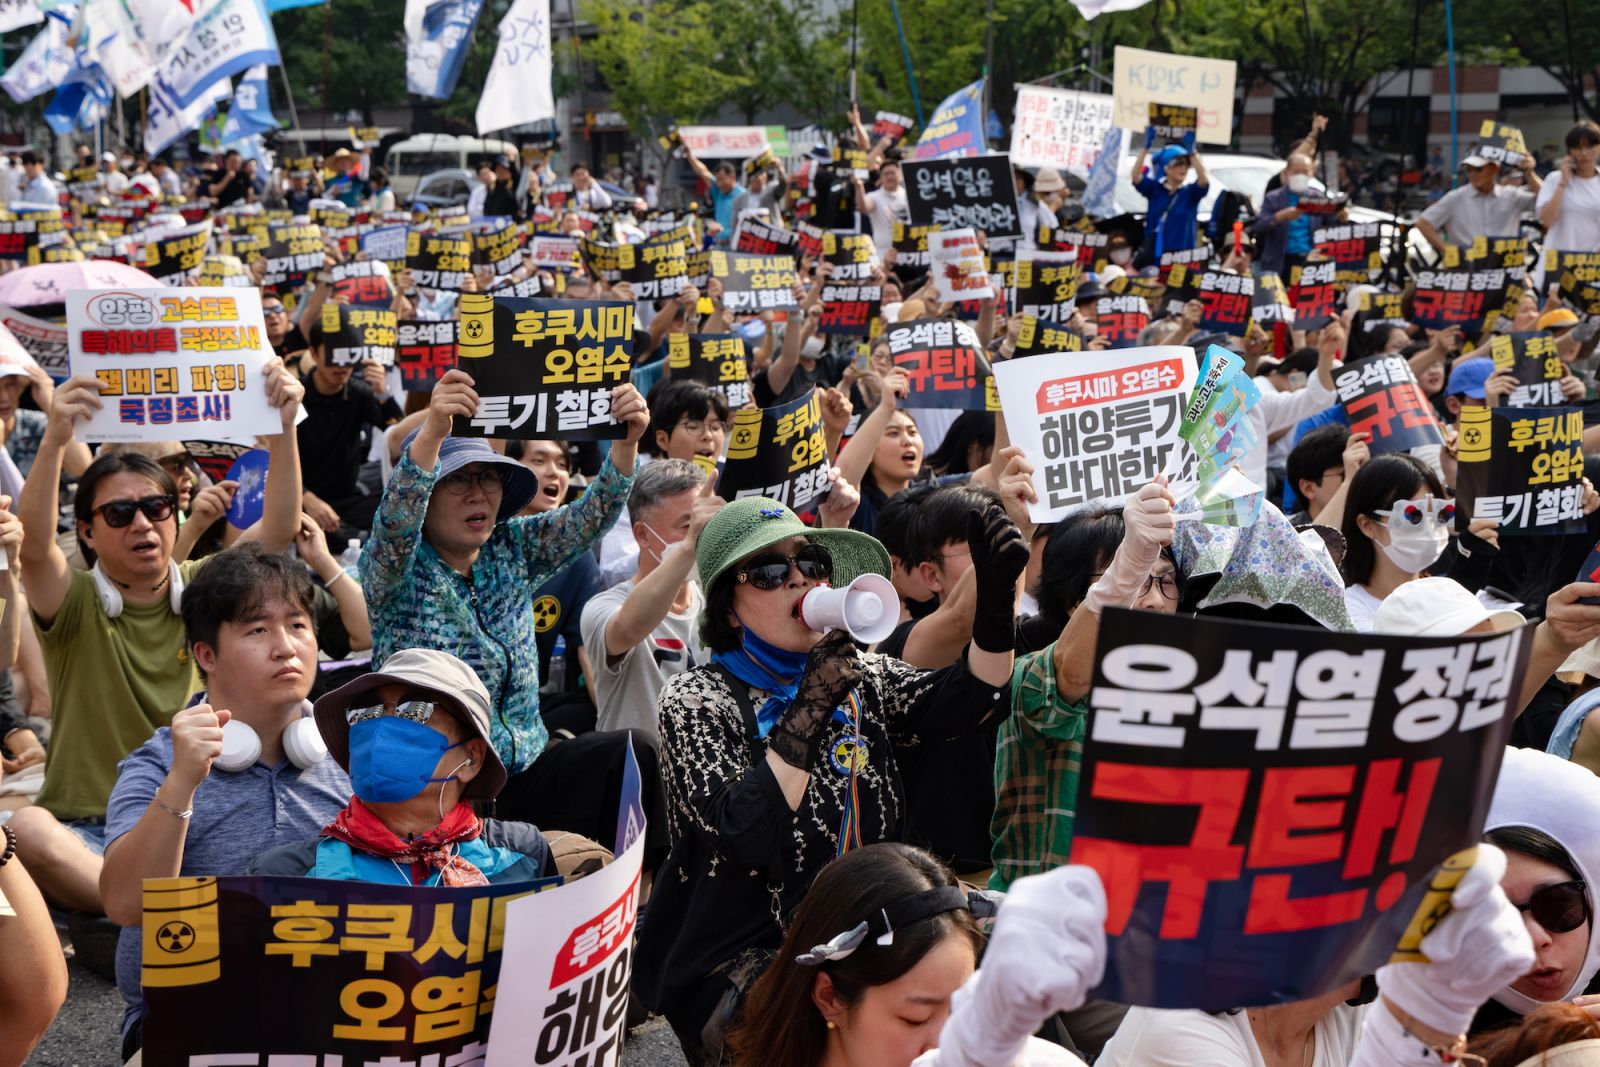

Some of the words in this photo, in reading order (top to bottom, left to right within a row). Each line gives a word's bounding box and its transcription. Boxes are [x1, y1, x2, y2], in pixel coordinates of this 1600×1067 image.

[735, 255, 794, 274] 후쿠시마
[1415, 271, 1469, 291] 윤석열
[1470, 268, 1505, 291] 정권
[751, 273, 795, 289] 오염수
[822, 286, 859, 301] 윤석열
[99, 298, 153, 325] 양평
[160, 296, 239, 323] 고속도로
[723, 290, 757, 309] 투기
[821, 302, 869, 326] 규탄!
[1412, 290, 1484, 321] 규탄!
[81, 327, 178, 356] 특혜의혹
[399, 321, 454, 345] 윤석열
[512, 304, 635, 348] 후쿠시마
[889, 321, 954, 352] 윤석열
[701, 337, 745, 362] 후쿠시
[1524, 336, 1557, 359] 후쿠
[191, 364, 246, 393] 파행!
[542, 345, 631, 385] 오염수
[893, 348, 977, 392] 규탄!
[1335, 357, 1409, 402] 윤석열
[1046, 376, 1118, 406] 후쿠시마
[1122, 366, 1177, 393] 오염수
[119, 395, 232, 425] 국정조사!
[470, 392, 548, 435] 투기
[555, 387, 619, 431] 철회
[772, 394, 821, 447] 후쿠시
[1040, 391, 1188, 460] 해양투기
[1528, 447, 1584, 485] 오염수
[1091, 644, 1386, 751] 윤석열
[1393, 627, 1523, 743] 정권
[1069, 757, 1443, 940] 규탄!
[333, 970, 500, 1044] 오염
